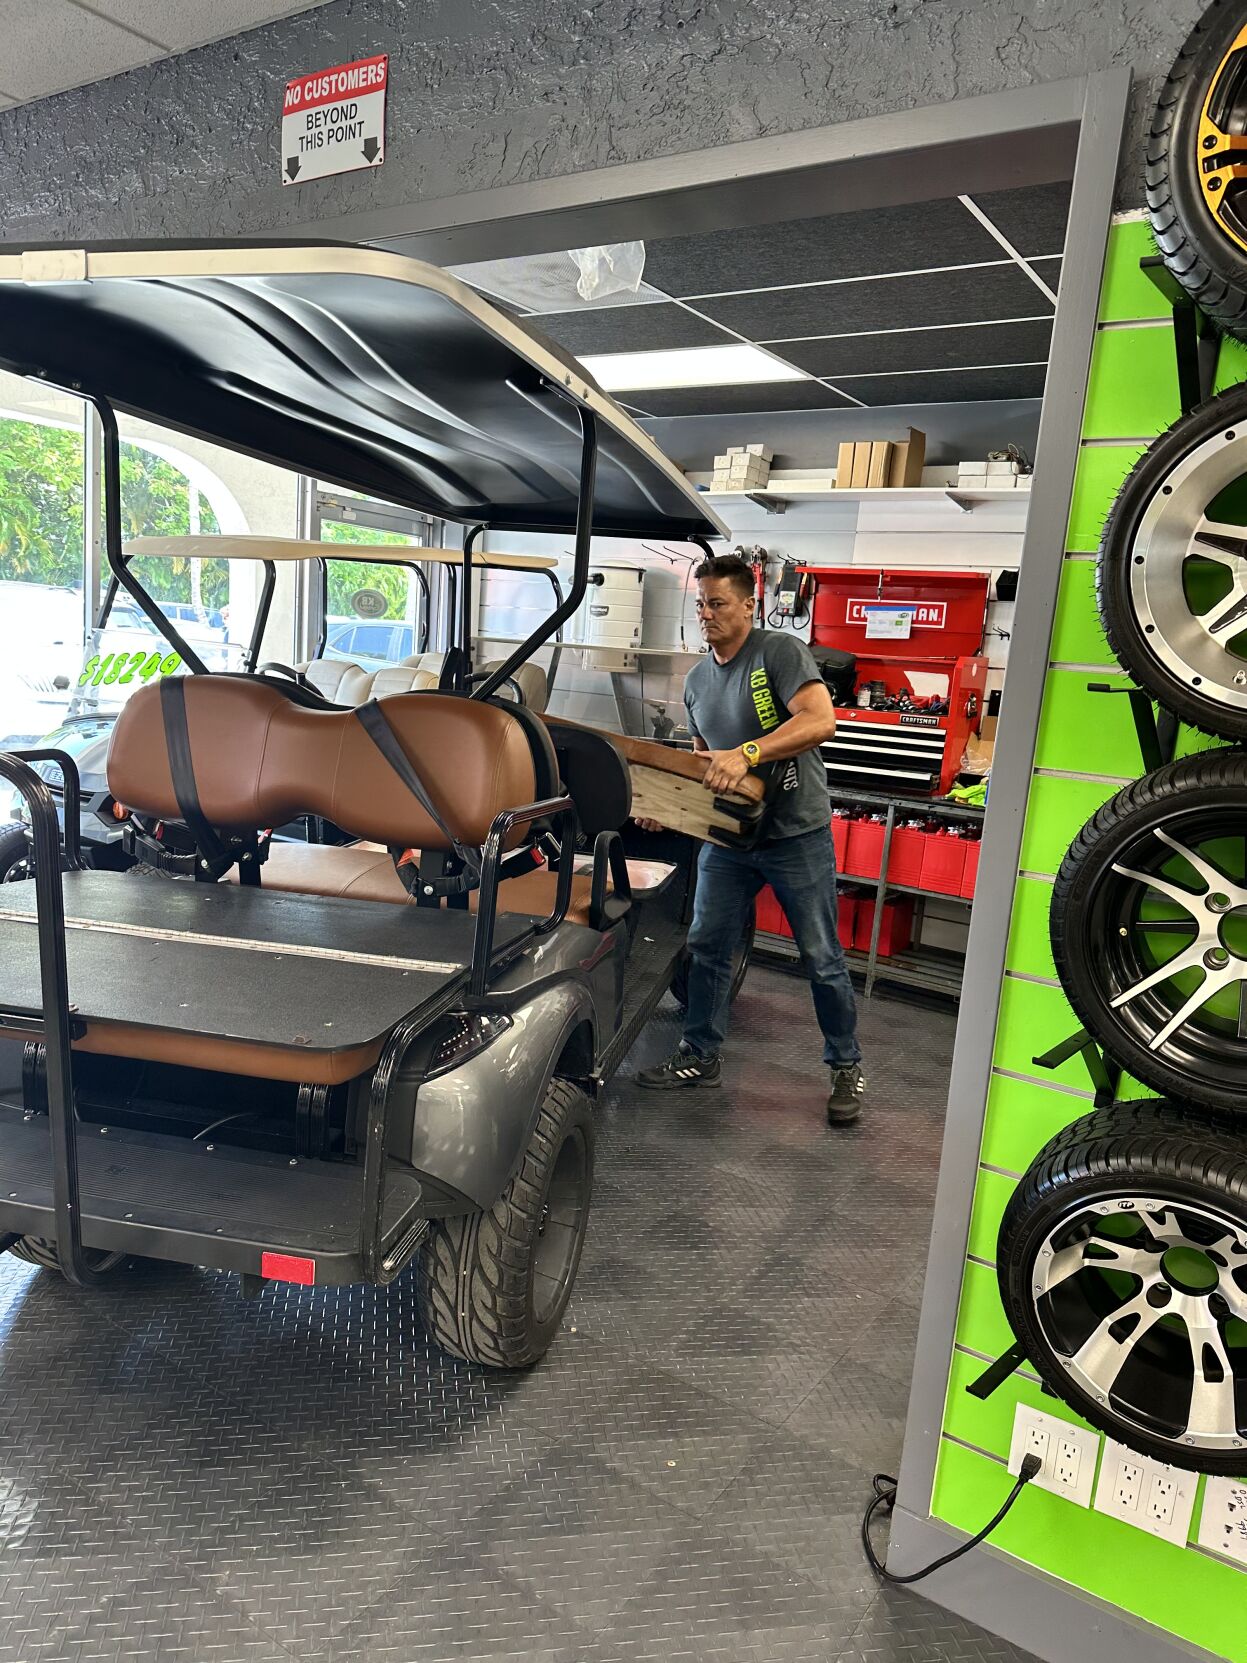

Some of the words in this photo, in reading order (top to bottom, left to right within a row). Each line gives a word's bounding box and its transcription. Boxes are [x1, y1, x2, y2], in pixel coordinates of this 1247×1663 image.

[284, 85, 302, 108] NO
[304, 62, 385, 101] CUSTOMERS
[306, 103, 358, 131] BEYOND
[298, 131, 324, 153] THIS
[327, 120, 365, 146] POINT
[78, 651, 182, 688] $18249
[750, 667, 768, 689] KB
[752, 687, 780, 730] GREEN
[902, 716, 937, 725] CRAFTSMAN
